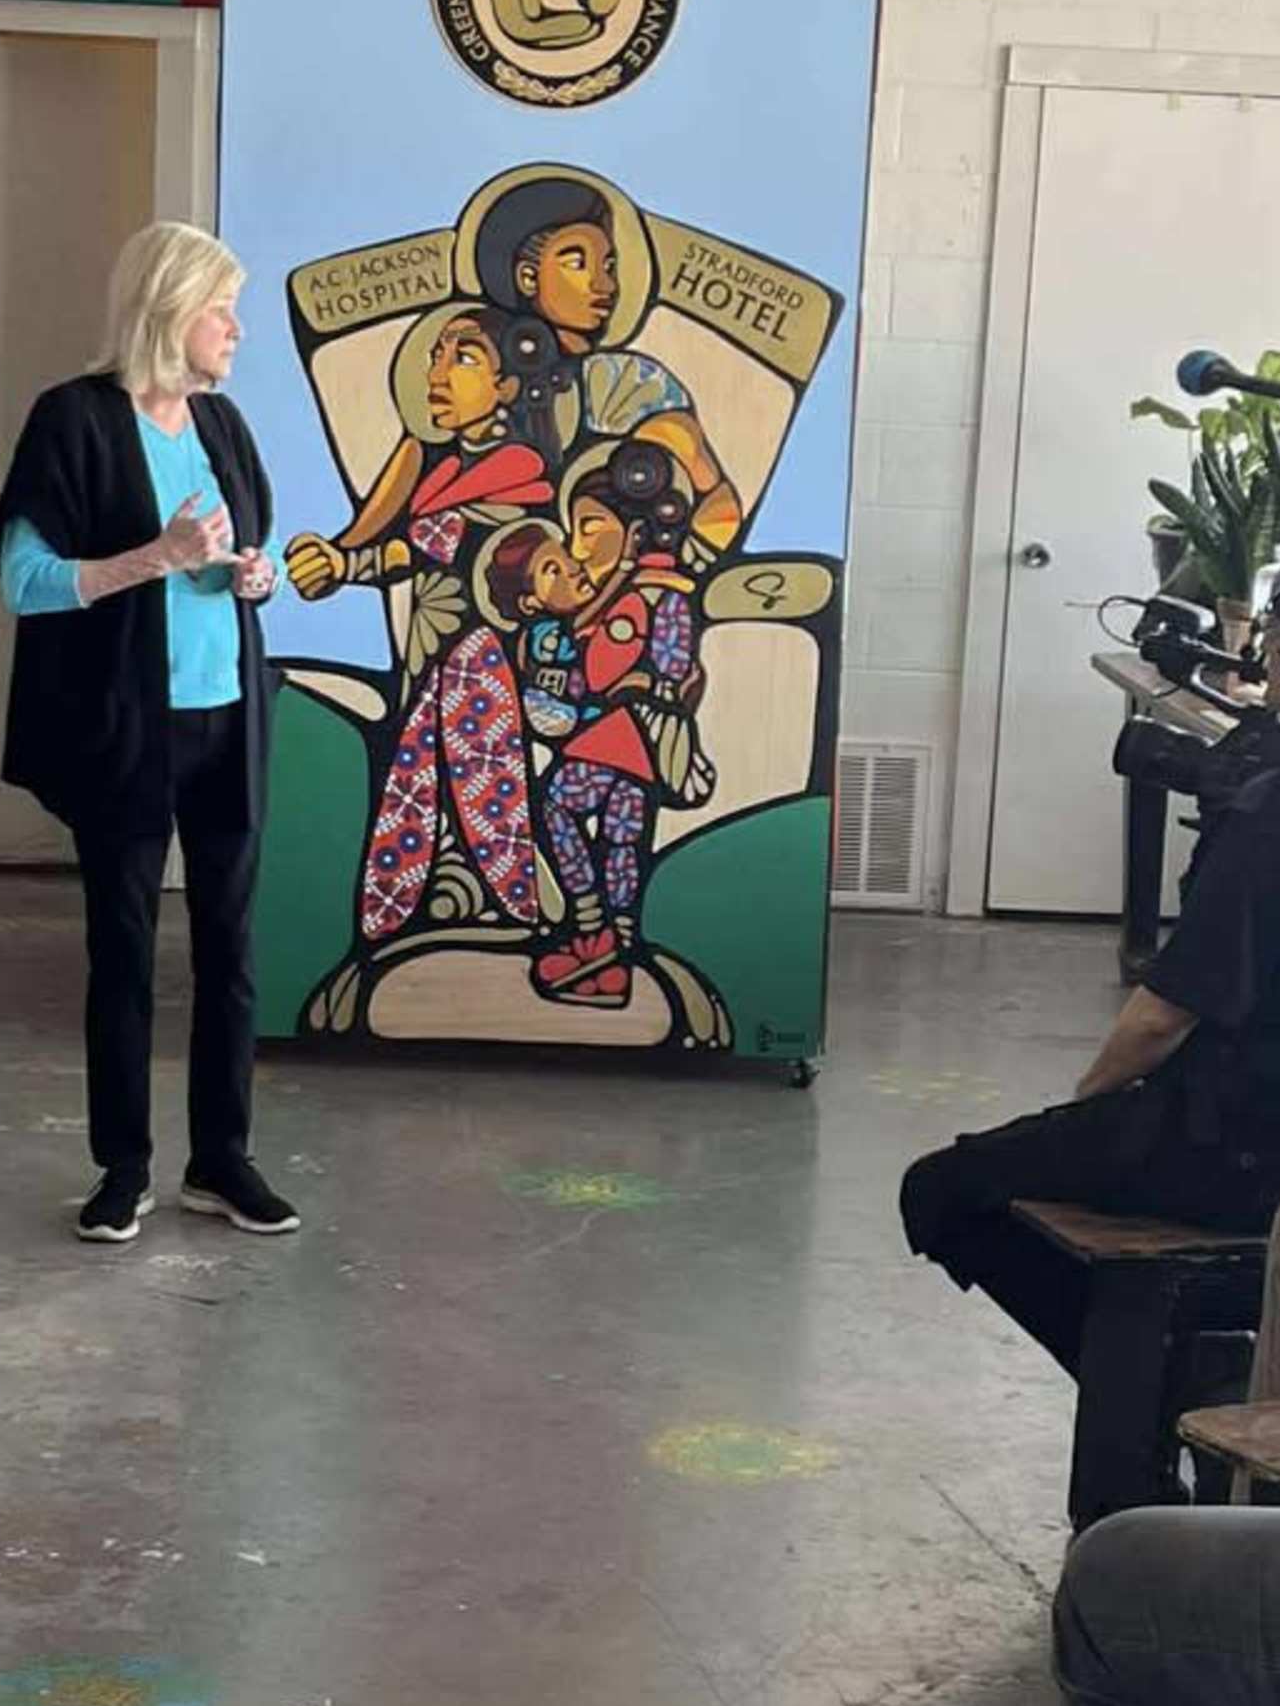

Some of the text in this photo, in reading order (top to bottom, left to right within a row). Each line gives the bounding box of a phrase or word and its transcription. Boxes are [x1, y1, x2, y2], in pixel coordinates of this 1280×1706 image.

[350, 242, 441, 286] JACKSON
[684, 241, 804, 309] STRADFORD
[315, 270, 447, 321] HOSPITAL
[671, 262, 788, 342] HOTEL
